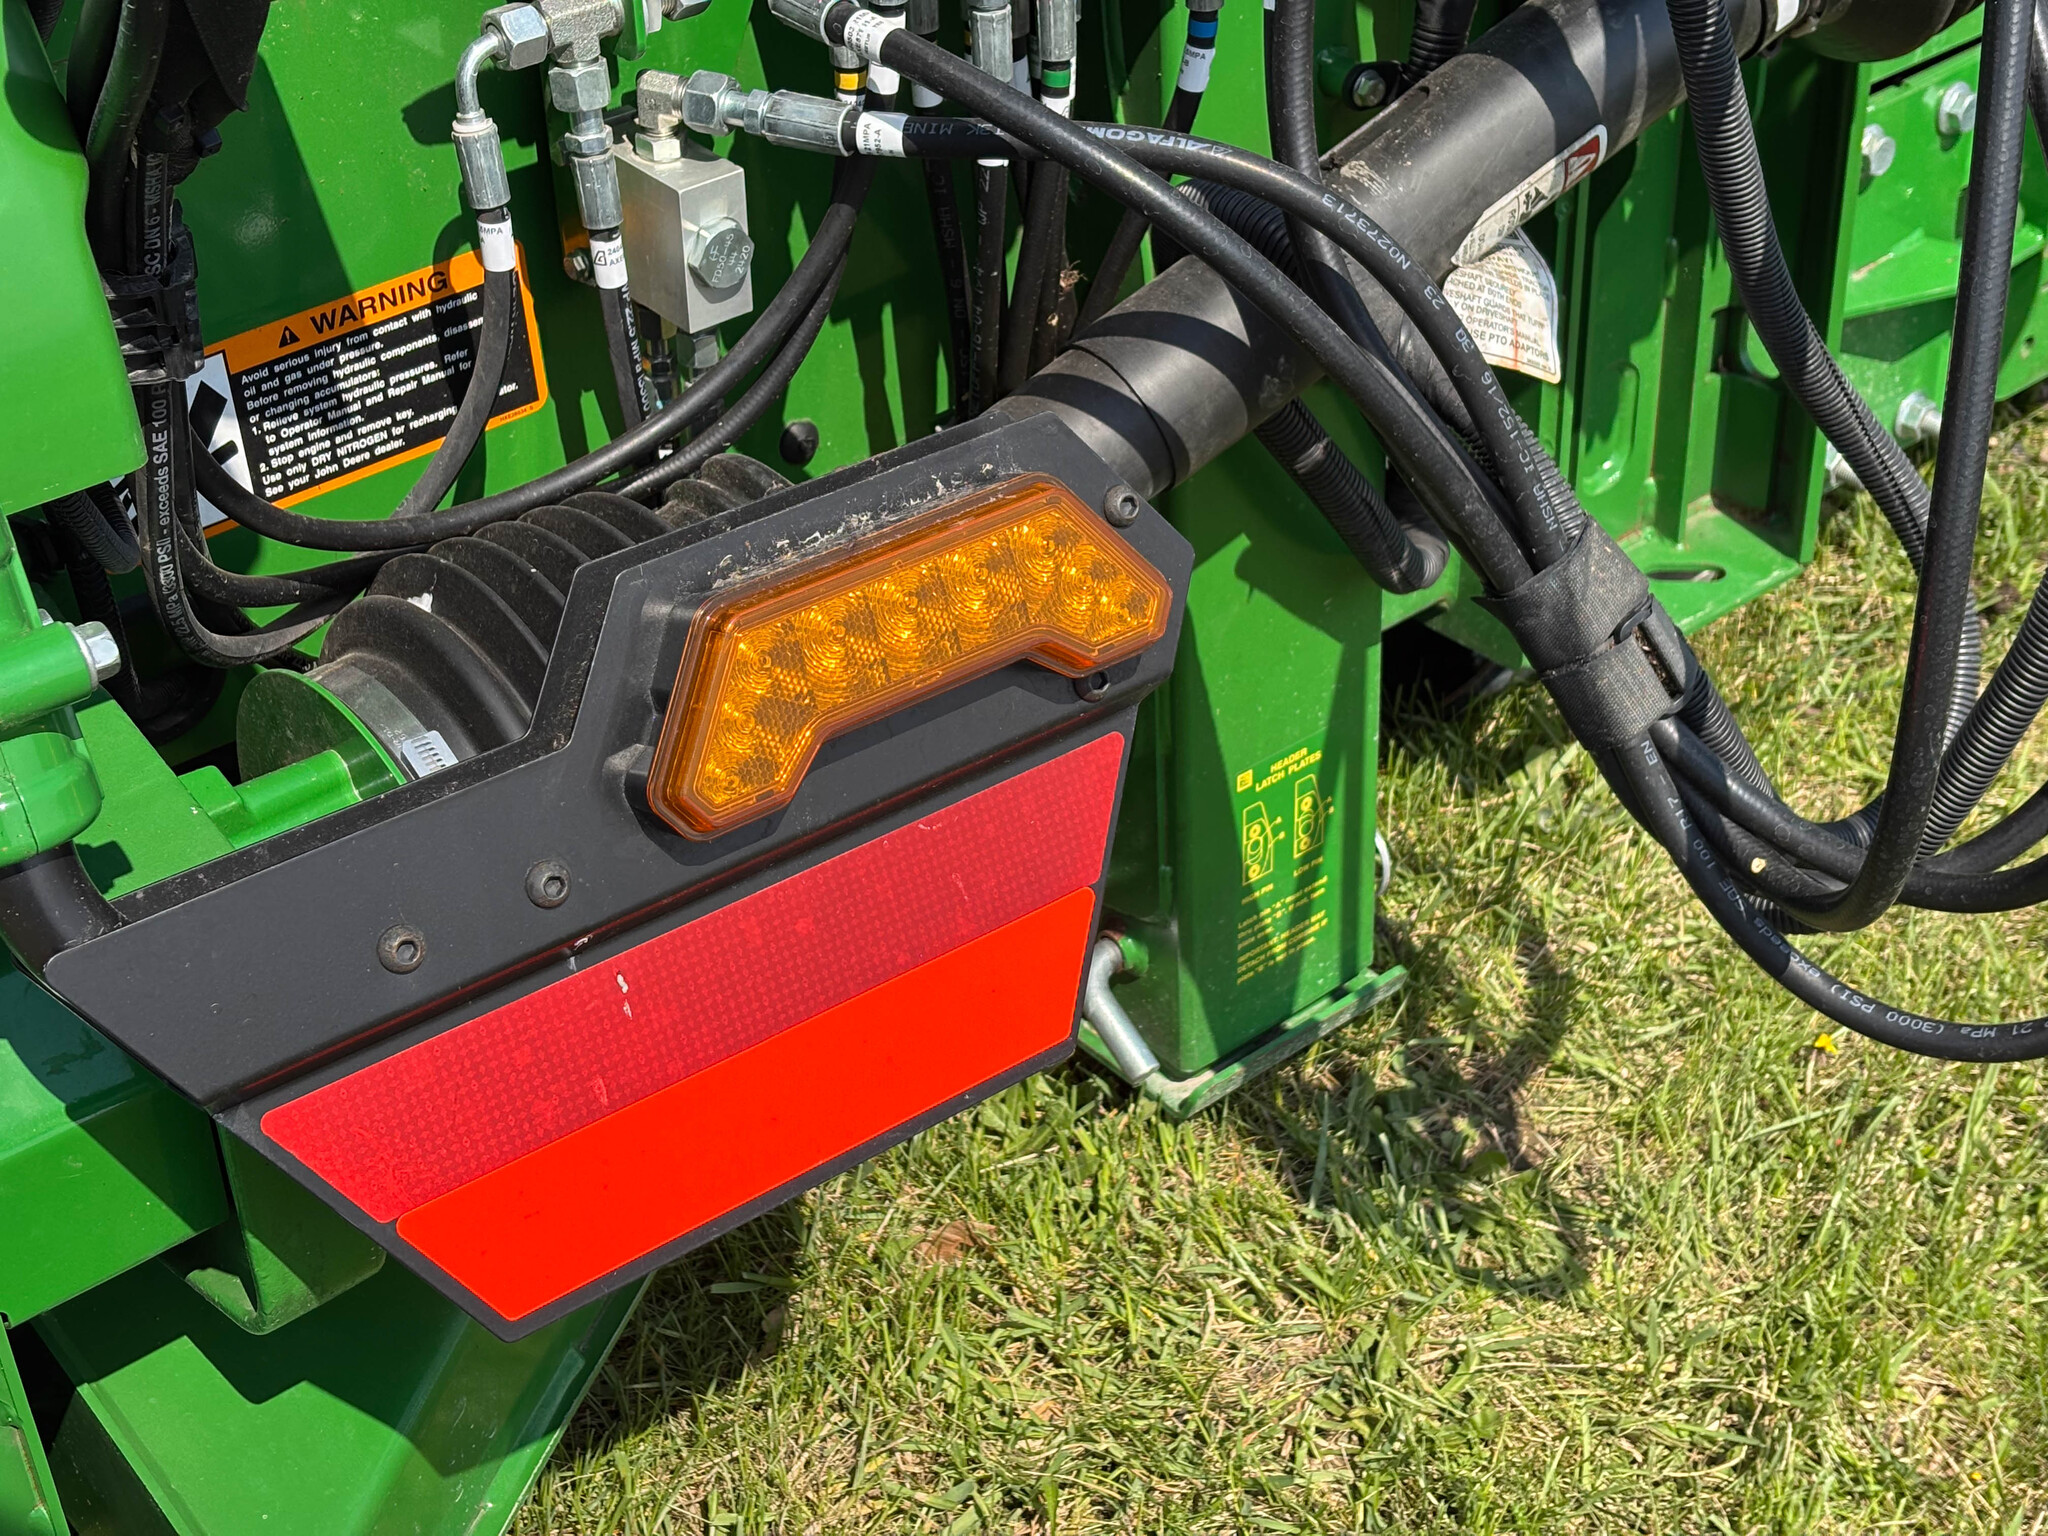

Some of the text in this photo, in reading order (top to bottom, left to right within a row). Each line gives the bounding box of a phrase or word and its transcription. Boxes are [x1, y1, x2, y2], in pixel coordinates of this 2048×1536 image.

[144, 166, 162, 206] MSHA
[144, 226, 160, 249] DN
[734, 245, 750, 274] 2420
[310, 271, 448, 334] WARNING
[1424, 285, 1445, 310] 23
[241, 291, 478, 385] Avoid serious injury from contact with hydraulic
[1488, 331, 1508, 346] PTO
[244, 341, 384, 398] oil and gas under pressure.
[246, 393, 278, 410] Before
[284, 374, 328, 398] removing
[333, 354, 376, 380] hydraulic
[380, 332, 440, 362] components,
[250, 368, 381, 424] or changing accumulators:
[252, 348, 468, 436] 1. Relieve system hydraulic pressures. Refer
[266, 360, 472, 444] to Operator Manual and Repair Manual for
[152, 400, 167, 428] 100
[152, 430, 168, 464] SAE
[259, 408, 414, 473] 2. Stop engine and remove key.
[262, 404, 458, 486] Use only DRY NITROGEN for recharging
[268, 414, 364, 456] system information.
[265, 438, 406, 497] See your John Deere dealer.
[154, 466, 170, 526] exceeds
[1532, 483, 1558, 532] MSHA
[1256, 750, 1322, 792] LATCH PLATES
[1270, 746, 1308, 774] HEADER
[1640, 738, 1658, 766] EN
[1668, 796, 1692, 830] R17
[1693, 838, 1716, 870] 100
[1753, 916, 1822, 978] exceeds
[1831, 984, 1879, 1015] PSI)
[1886, 1010, 1945, 1036] (3000
[1960, 1025, 1996, 1038] MPa
[2011, 1022, 2033, 1035] 21
